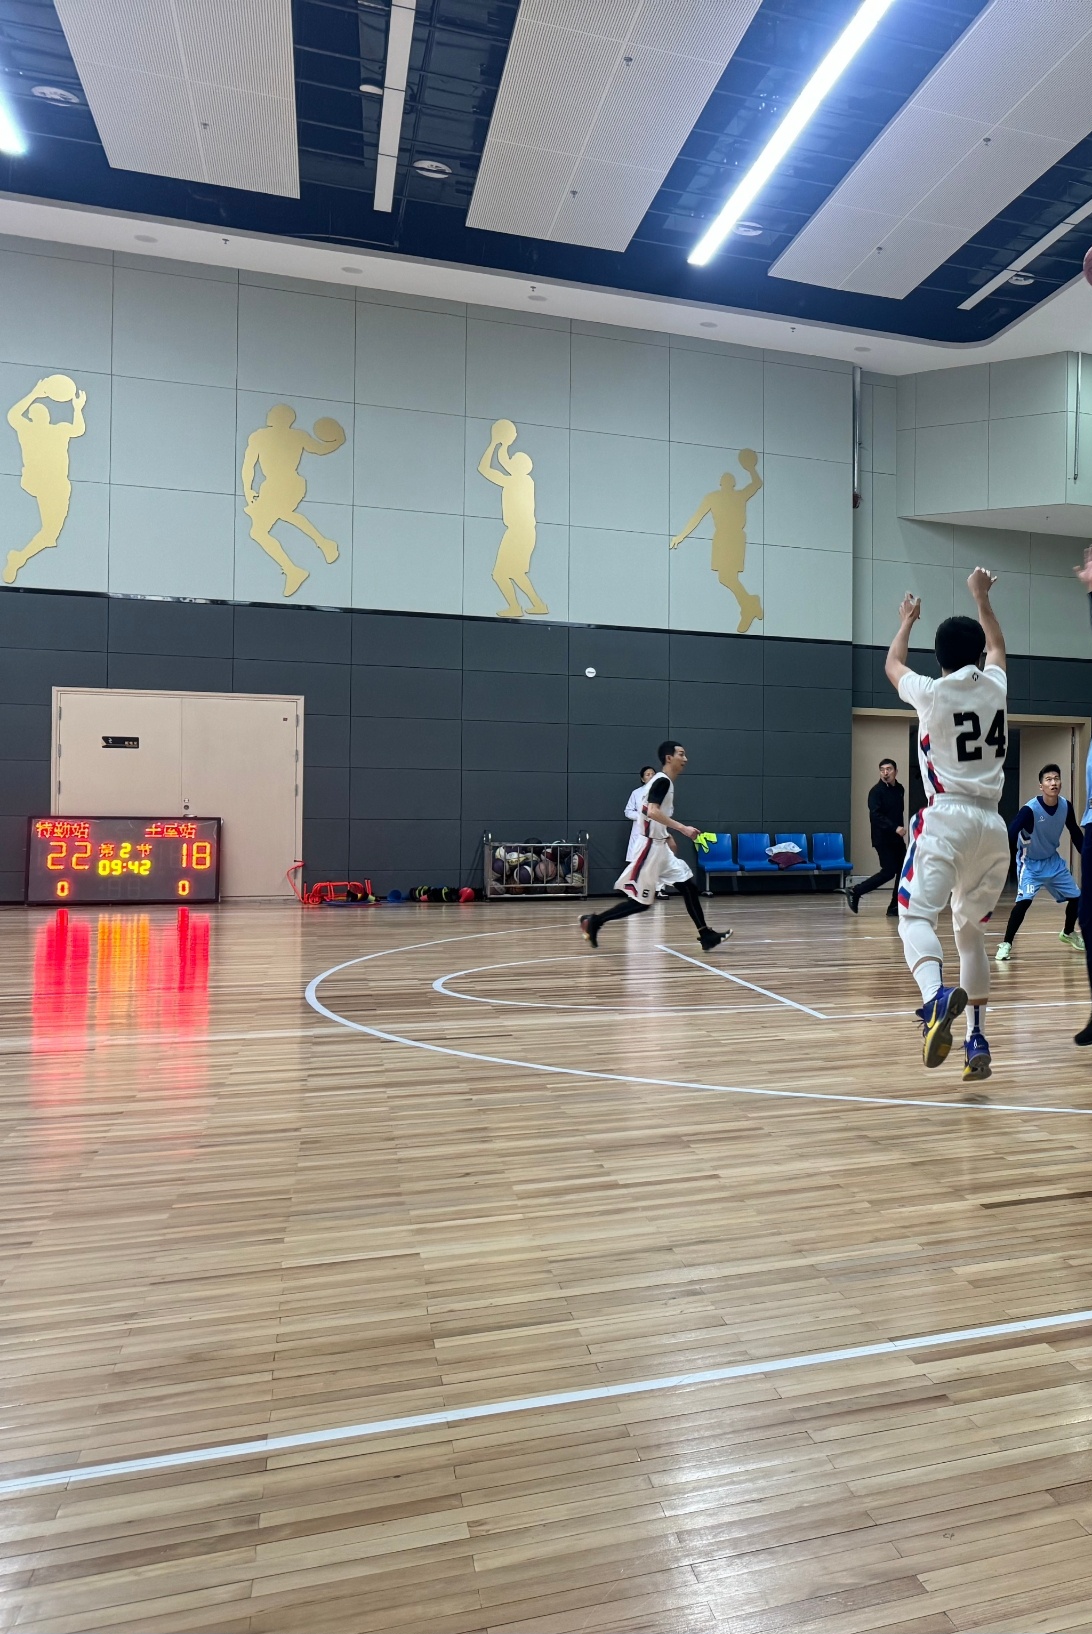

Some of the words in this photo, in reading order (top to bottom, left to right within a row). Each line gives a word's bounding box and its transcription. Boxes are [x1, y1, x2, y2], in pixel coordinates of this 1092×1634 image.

[953, 709, 1005, 762] 24
[47, 841, 92, 870] 22
[181, 841, 211, 870] 18
[98, 859, 152, 876] 09:42
[57, 881, 69, 897] 0
[178, 880, 190, 896] 0
